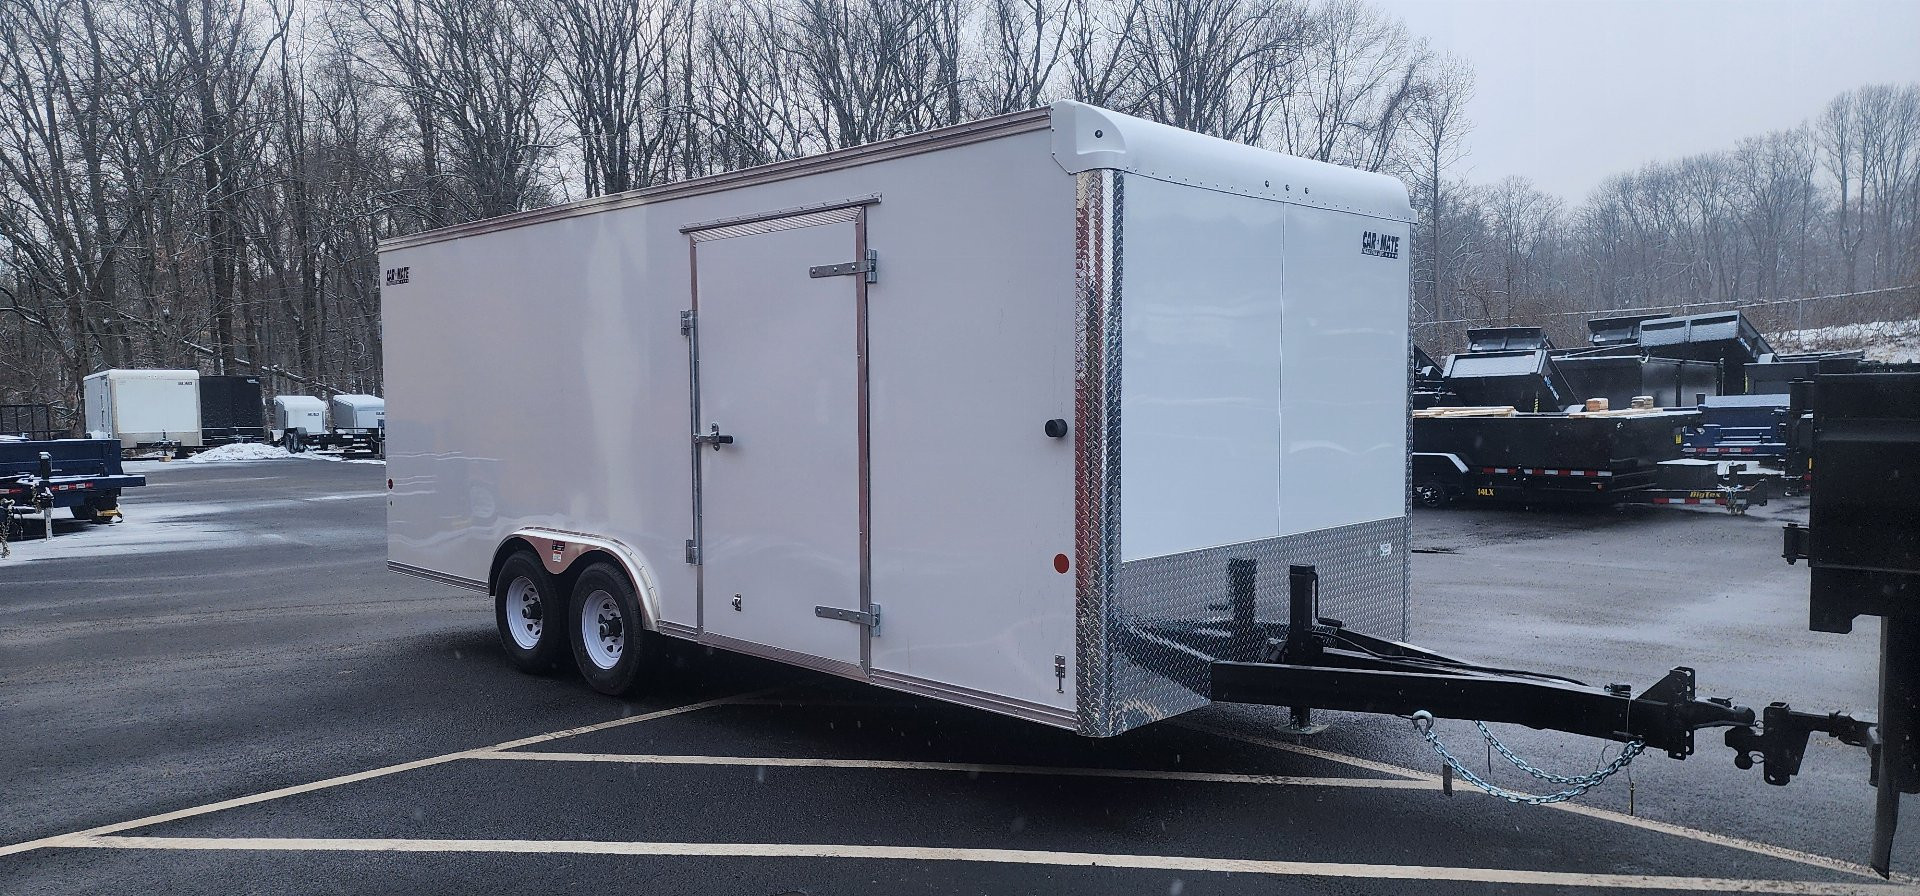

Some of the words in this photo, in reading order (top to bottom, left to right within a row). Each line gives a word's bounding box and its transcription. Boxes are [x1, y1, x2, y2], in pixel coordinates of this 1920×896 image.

[1362, 231, 1377, 249] CAR
[1380, 234, 1400, 252] MATE
[1477, 488, 1494, 496] 14LX
